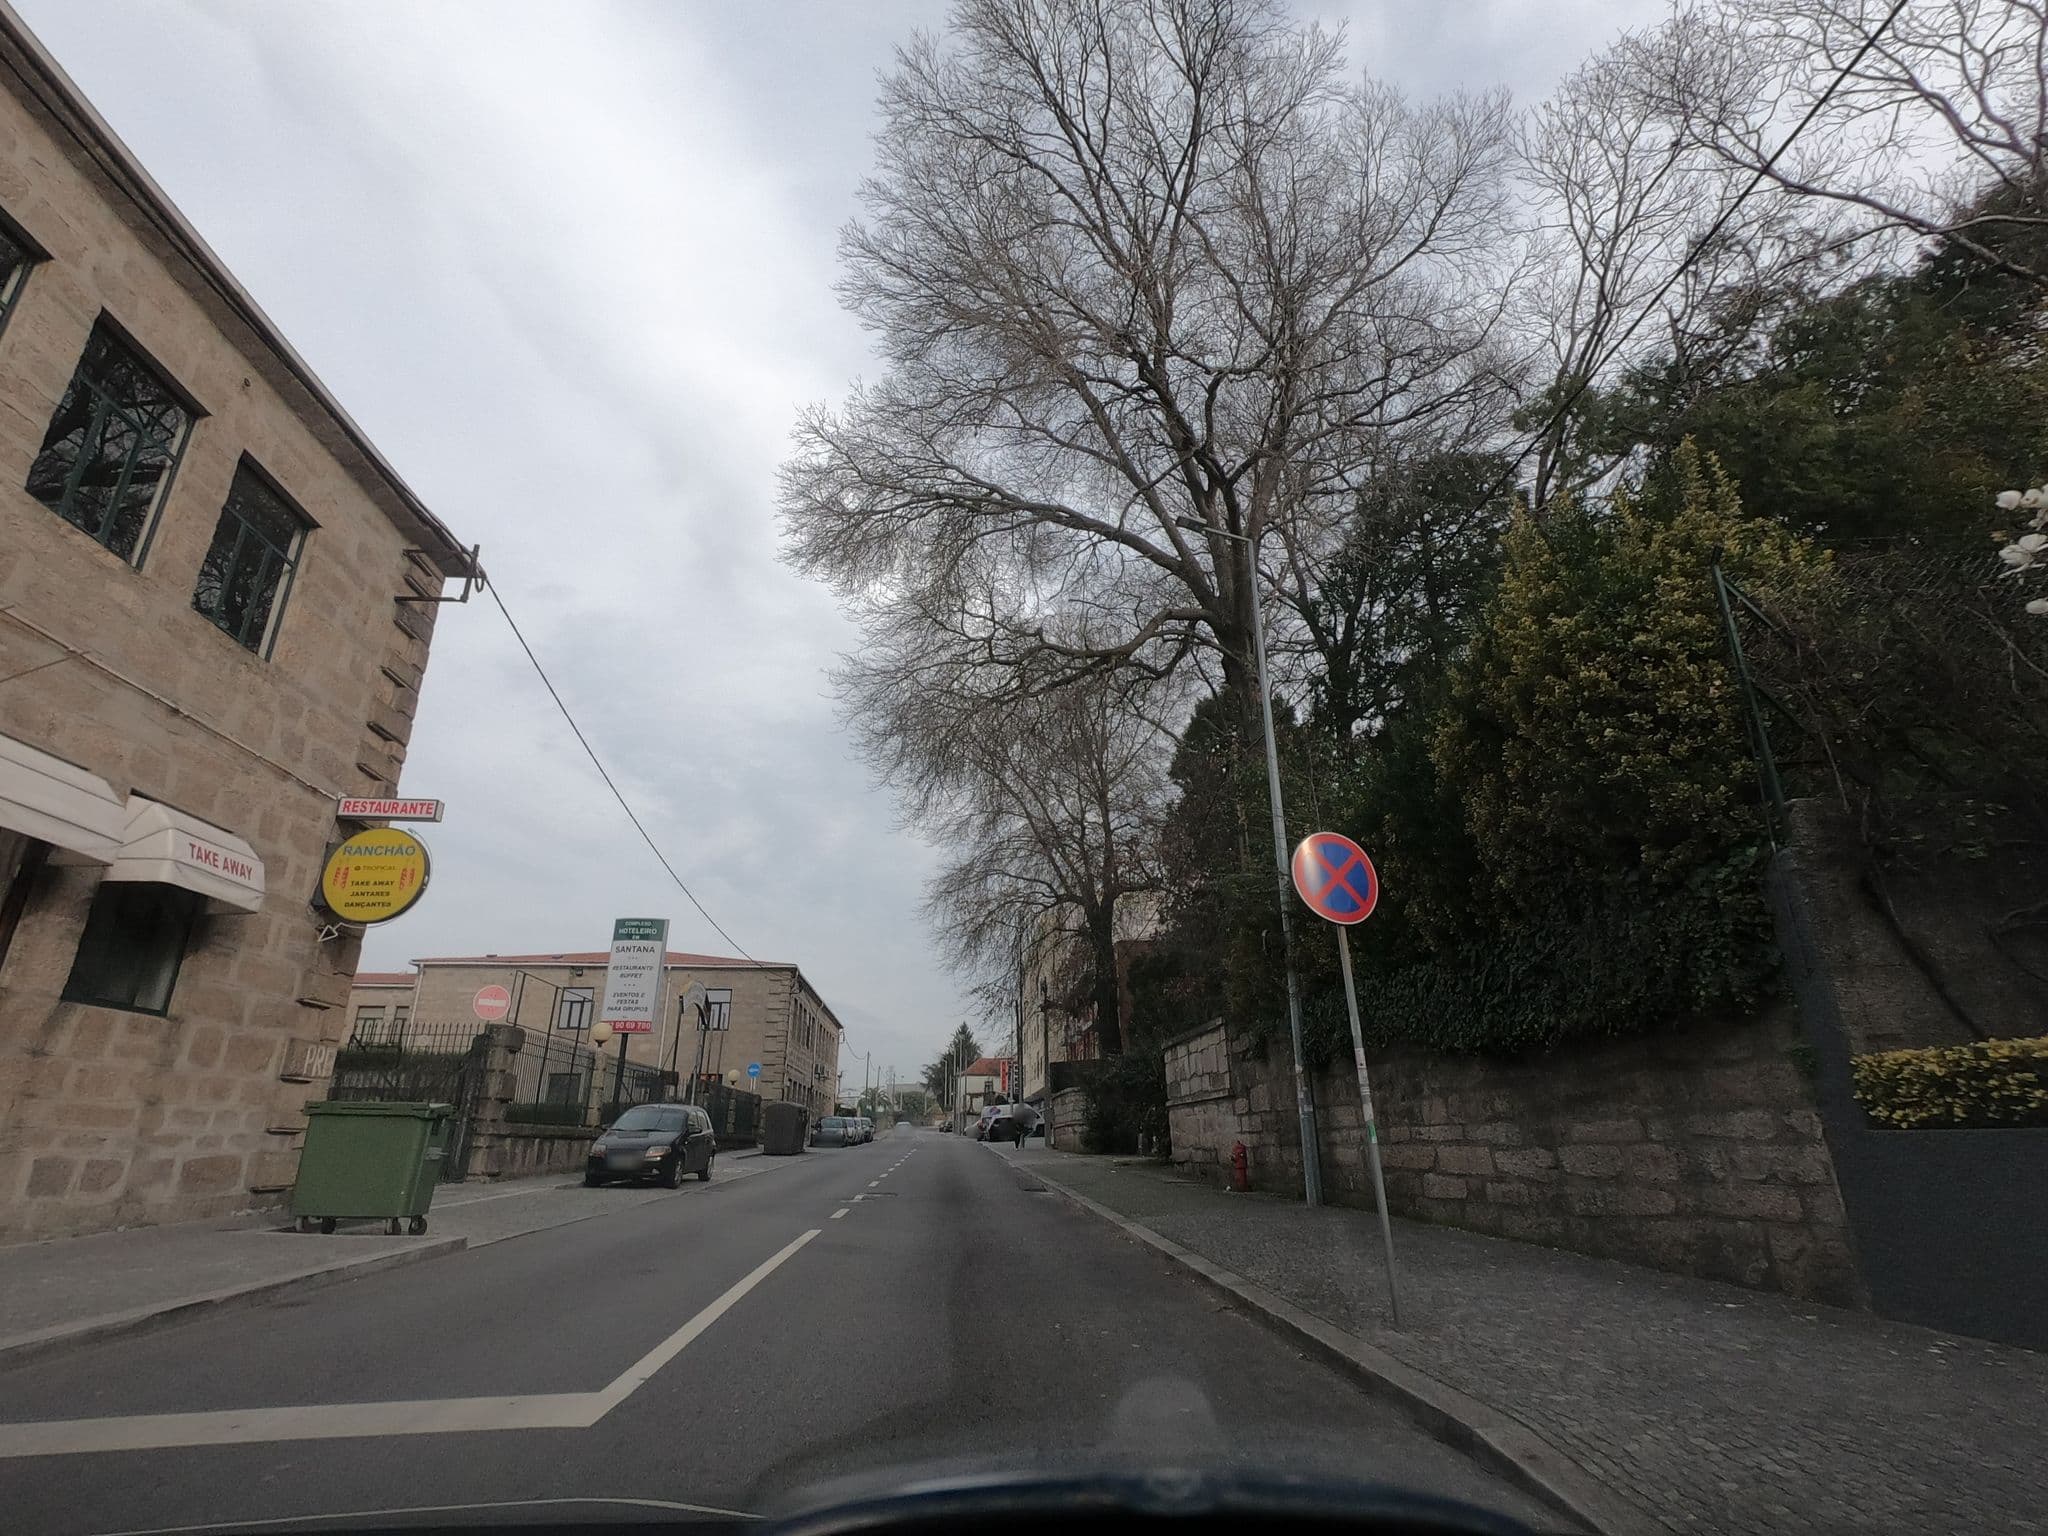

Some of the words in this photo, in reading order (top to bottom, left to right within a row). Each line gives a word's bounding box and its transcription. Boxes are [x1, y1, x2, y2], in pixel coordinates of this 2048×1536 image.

[342, 801, 434, 815] RESTAURANTE
[189, 842, 219, 869] TAKE
[222, 857, 253, 881] AWAY
[618, 927, 657, 935] HOTELEIRO
[615, 945, 656, 953] SANTANA
